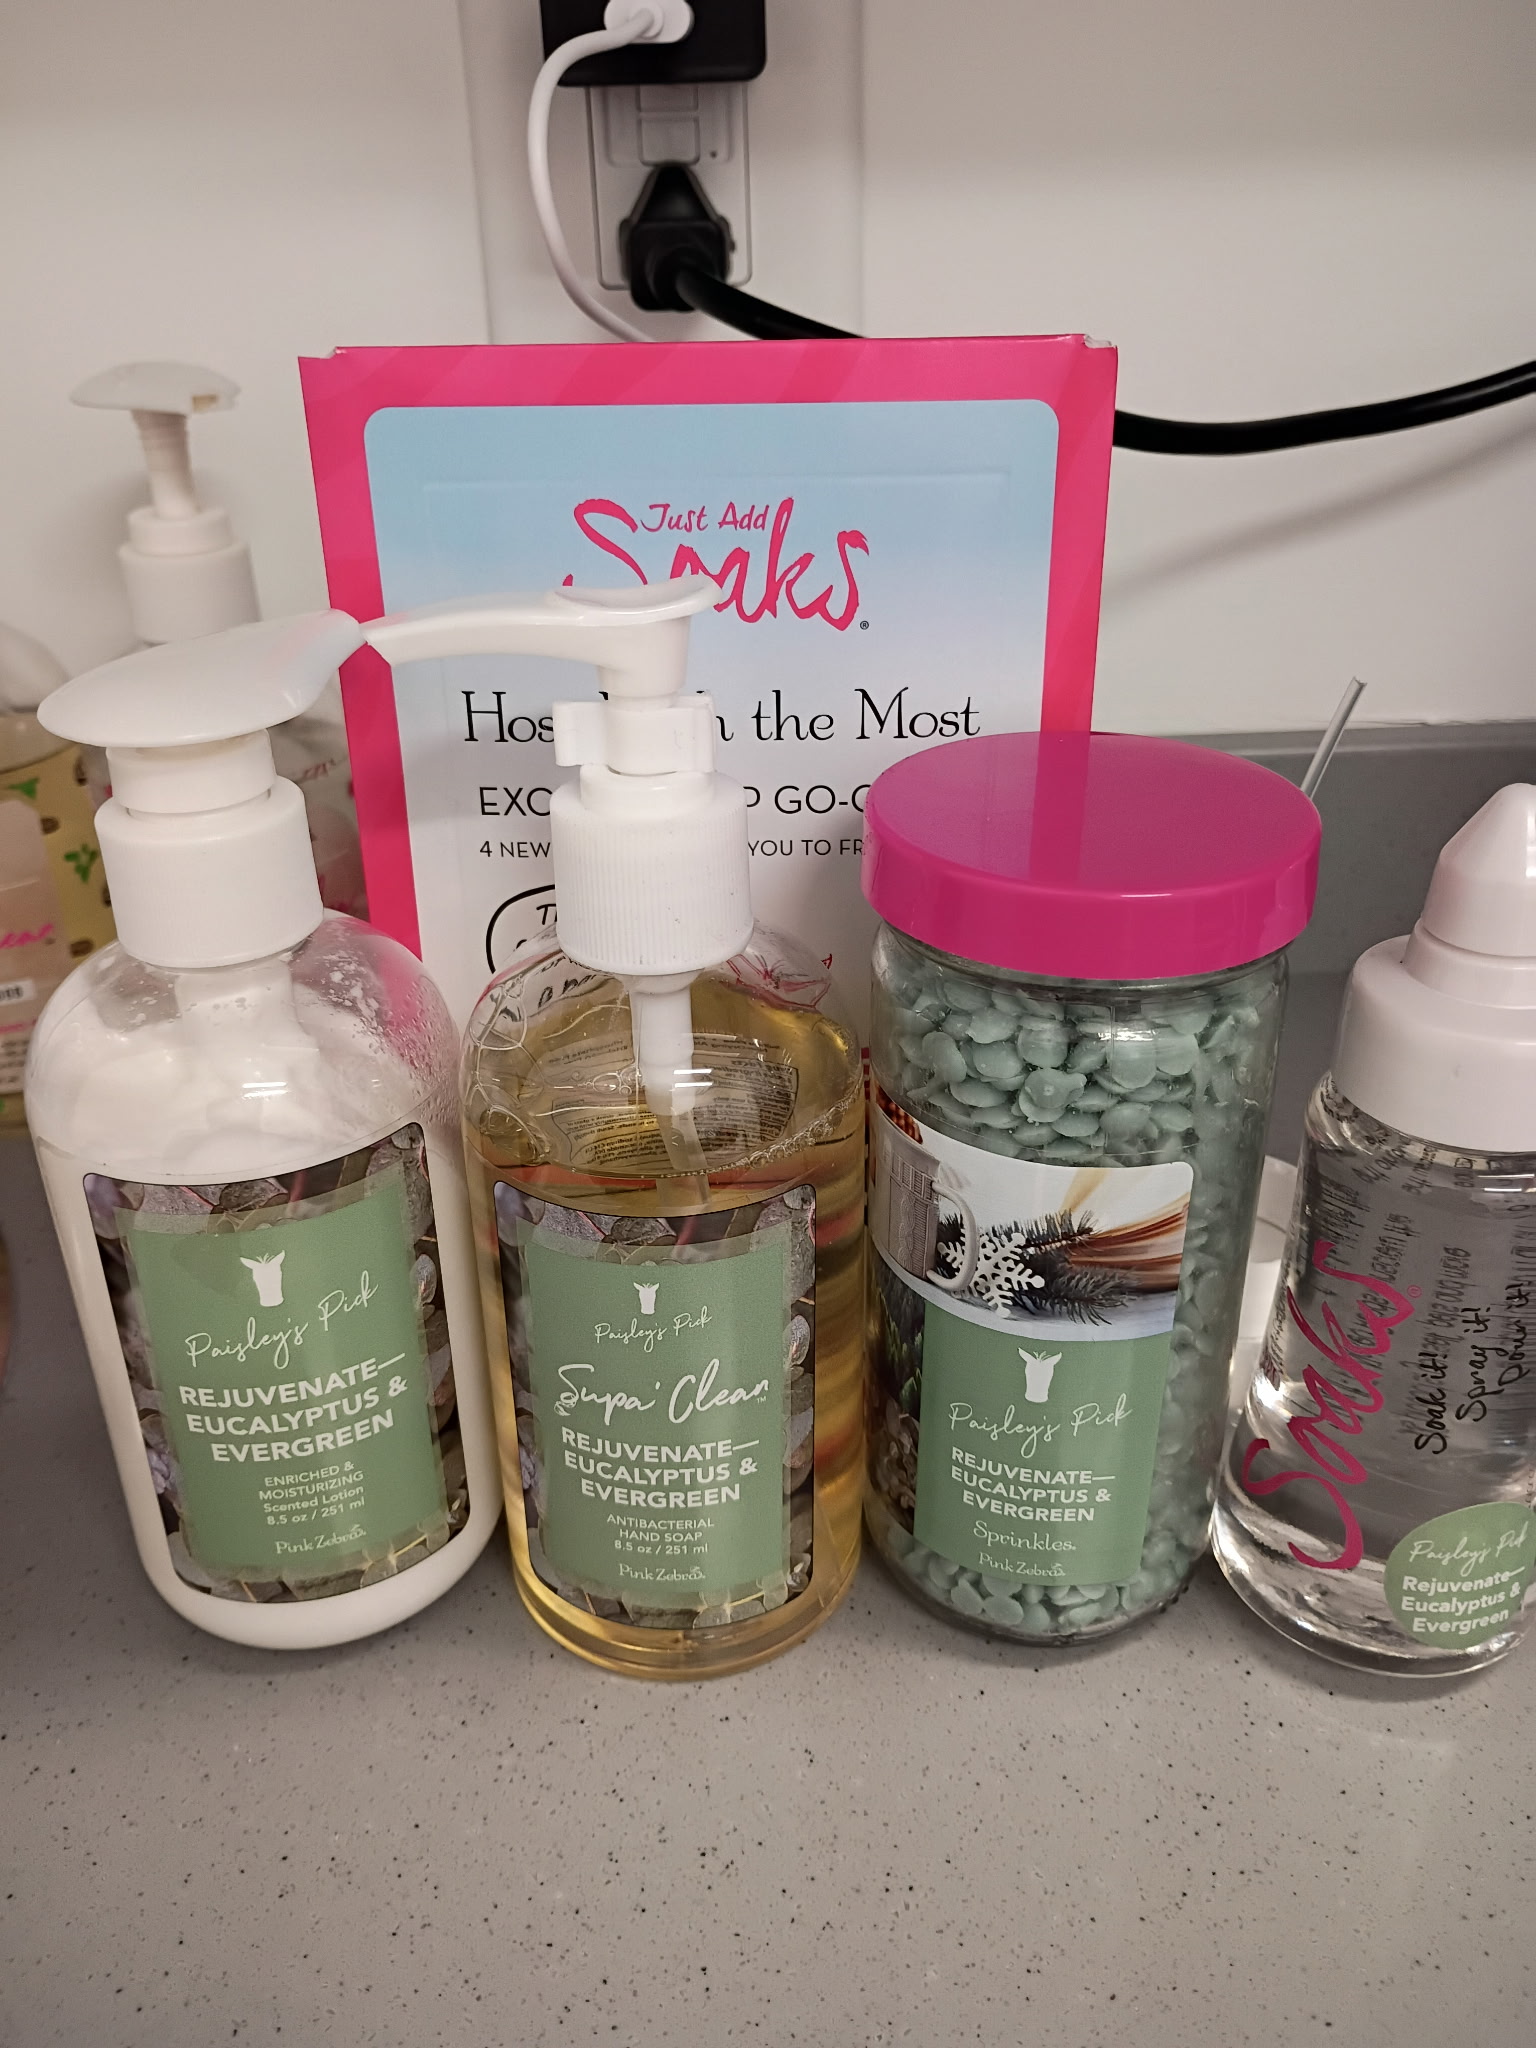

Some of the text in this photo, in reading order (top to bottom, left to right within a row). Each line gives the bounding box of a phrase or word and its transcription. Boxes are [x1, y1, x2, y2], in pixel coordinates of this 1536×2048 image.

[640, 501, 770, 533] Just Add
[751, 690, 835, 742] the
[854, 687, 981, 741] Most
[479, 840, 493, 858] 4
[499, 841, 551, 858] NEW
[747, 839, 793, 857] YOU
[801, 839, 831, 856] TO
[1505, 1282, 1531, 1310] it!
[185, 1270, 379, 1370] Paisley's Pick
[594, 1305, 713, 1353] Paisley's Pick
[1455, 1307, 1509, 1422] Spray it!
[1498, 1319, 1531, 1387] Pour
[186, 1375, 408, 1435] EUCALYPTUS &
[668, 1358, 769, 1424] Clean
[1414, 1352, 1448, 1455] Soak it!
[211, 1409, 394, 1463] EVERGREEN
[948, 1392, 1133, 1459] Paisley's Pick
[264, 1461, 355, 1487] ENRICHED &
[563, 1450, 758, 1487] EUCALYPTUS &
[951, 1465, 1112, 1503] EUCALYPTUS &
[259, 1471, 364, 1500] MOISTURIZING
[263, 1486, 364, 1513] Scented Lotion
[580, 1477, 741, 1508] EVERGREEN
[267, 1514, 288, 1526] 8.5
[292, 1512, 308, 1523] oz
[321, 1504, 345, 1519] 251
[349, 1499, 366, 1511] ml
[606, 1513, 715, 1529] ANTIBACTERIAL
[962, 1489, 1095, 1522] EVERGREEN
[614, 1539, 634, 1552] 8.5
[637, 1544, 652, 1554] oz
[665, 1544, 688, 1555] 251
[692, 1543, 709, 1555] ml
[619, 1528, 703, 1543] HAND SOAP
[1401, 1582, 1521, 1616] Eucalyptus &
[1412, 1609, 1509, 1635] Evergreen
